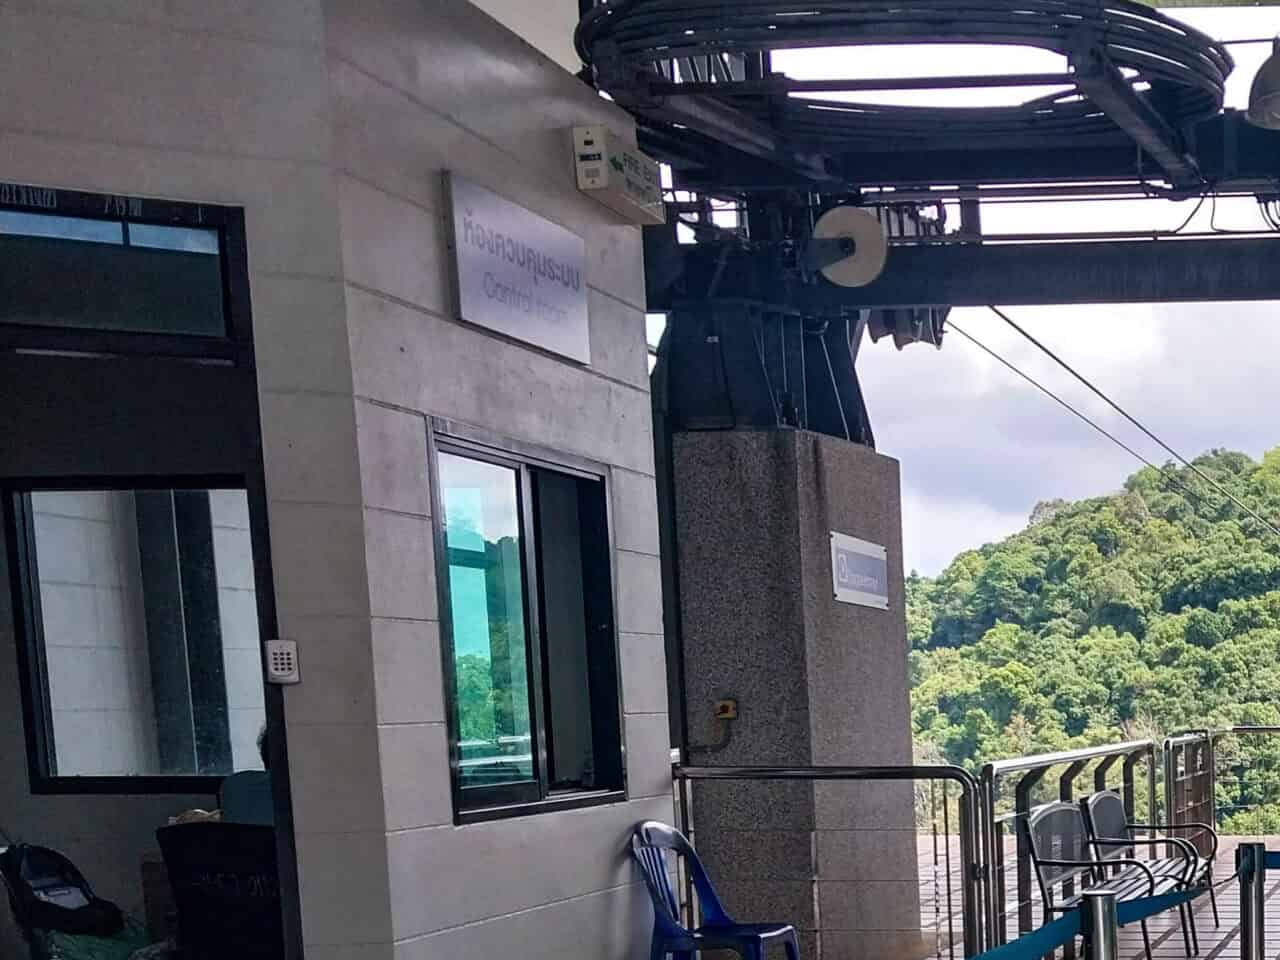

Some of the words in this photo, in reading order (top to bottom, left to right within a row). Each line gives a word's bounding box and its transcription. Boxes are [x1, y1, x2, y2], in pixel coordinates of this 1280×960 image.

[463, 208, 580, 291] ห้องควบคุมระบบ
